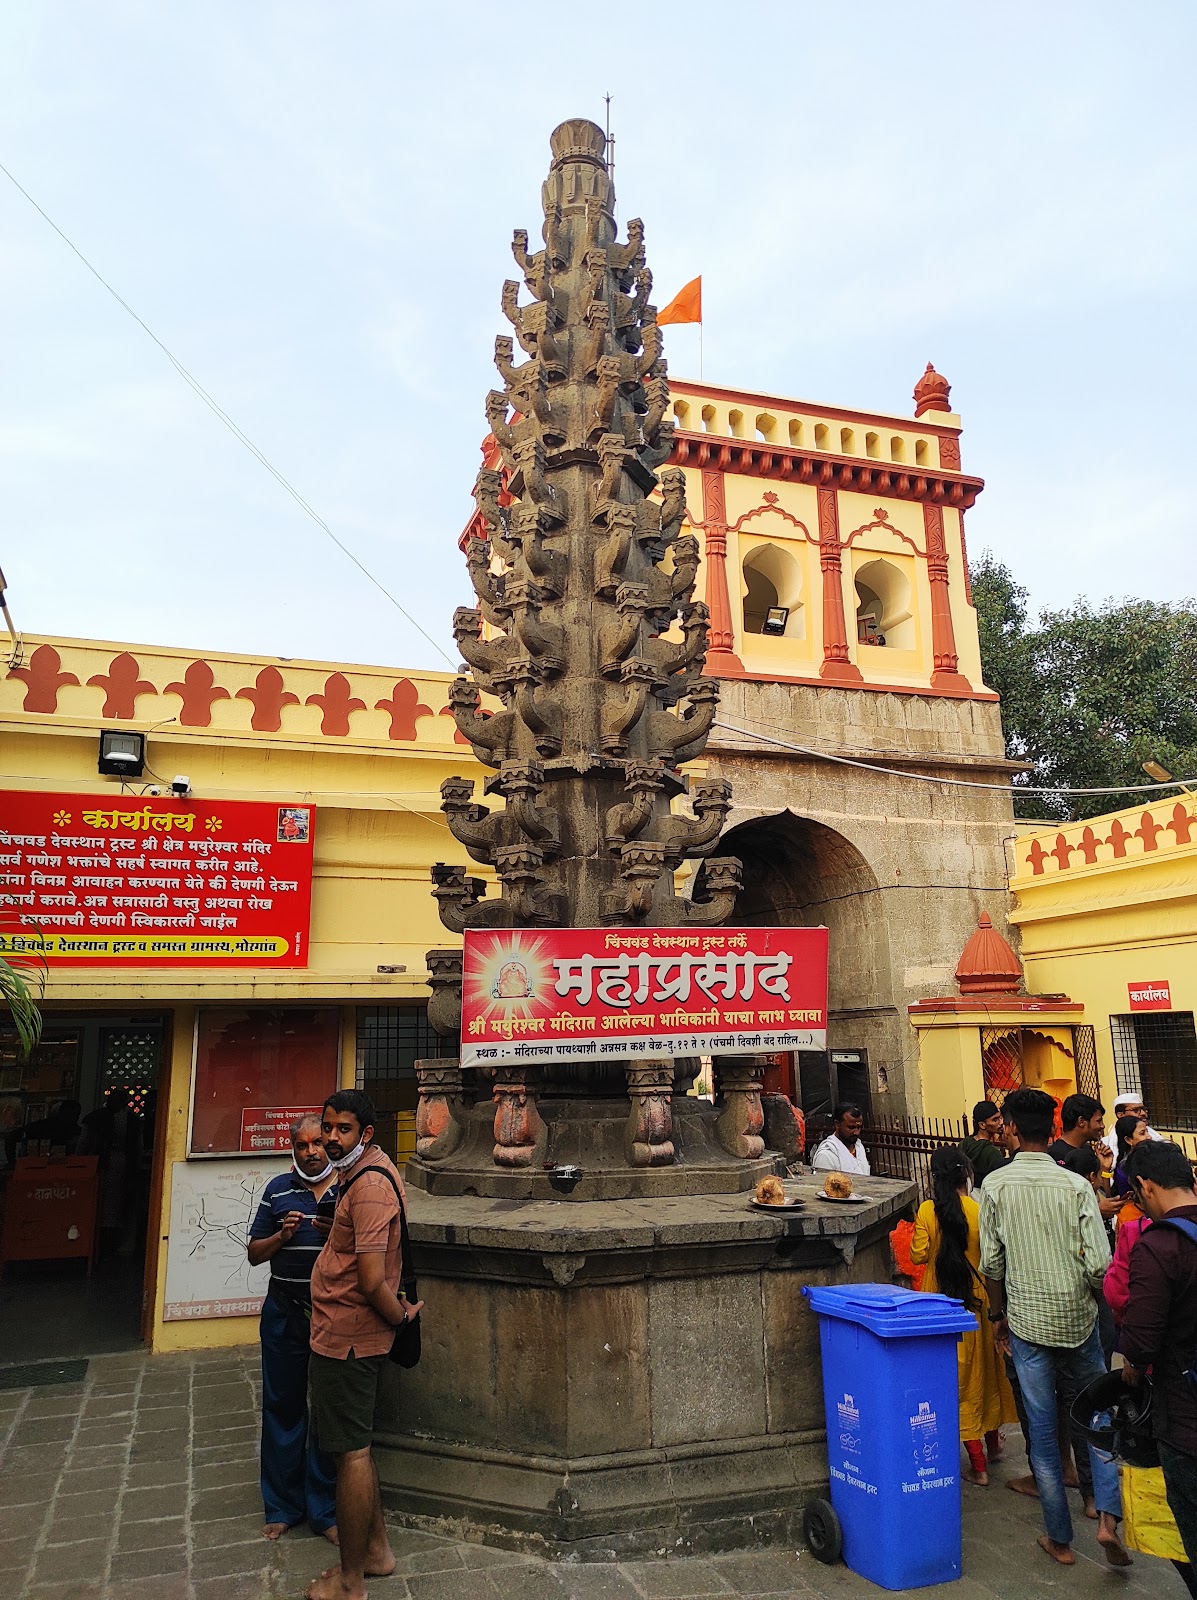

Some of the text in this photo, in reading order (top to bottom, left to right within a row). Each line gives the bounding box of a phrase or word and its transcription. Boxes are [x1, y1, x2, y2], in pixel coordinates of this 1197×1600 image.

[82, 806, 196, 832] कार्यालय
[50, 832, 105, 848] देवस्थान
[109, 838, 136, 852] ट्रस्ट
[141, 835, 158, 850] श्री
[163, 836, 184, 852] क्षेत्र
[188, 837, 238, 856] मयुरेश्वर
[242, 839, 272, 854] मंदिर
[26, 851, 62, 868] गणेश
[66, 852, 111, 868] भक्तांचे
[115, 854, 145, 870] सहर्ष
[149, 859, 191, 870] स्वागत
[195, 856, 229, 872] करीत
[72, 875, 124, 889] आवाहन
[127, 877, 181, 889] करण्यात
[184, 874, 204, 890] येते
[208, 875, 227, 890] की
[231, 875, 265, 891] देणगी
[269, 876, 298, 892] देऊन
[112, 893, 168, 908] सत्रासाठी
[173, 897, 200, 913] वस्तु
[204, 898, 243, 909] अथवा
[247, 895, 272, 910] रोख
[89, 911, 126, 927] देणगी
[130, 912, 196, 927] स्विकारली
[199, 913, 237, 930] जाईल
[58, 937, 108, 951] देवस्थान
[112, 941, 136, 953] ट्रस्ट
[151, 942, 186, 952] समस्त
[605, 933, 747, 950] चिंचवड देवस्थान ट्रस्ट तर्फे
[553, 951, 793, 1008] महाप्रसाद
[1129, 985, 1169, 1002] कार्यालय
[467, 1007, 822, 1040] श्री मयुरेश्वर मंदिरात आलेल्या भाविकांनी याचा लाभ घ्यावा
[476, 1048, 498, 1059] स्थळ
[514, 1043, 553, 1057] मंदिराच्या
[556, 1041, 596, 1055] पायथ्याशी
[600, 1042, 627, 1053] अन्नसत्र
[630, 1041, 645, 1051] कक्ष
[691, 1037, 697, 1048] ते
[709, 1036, 735, 1049] (पंचमी
[738, 1034, 760, 1047] दिवशी
[763, 1035, 775, 1046] बंद
